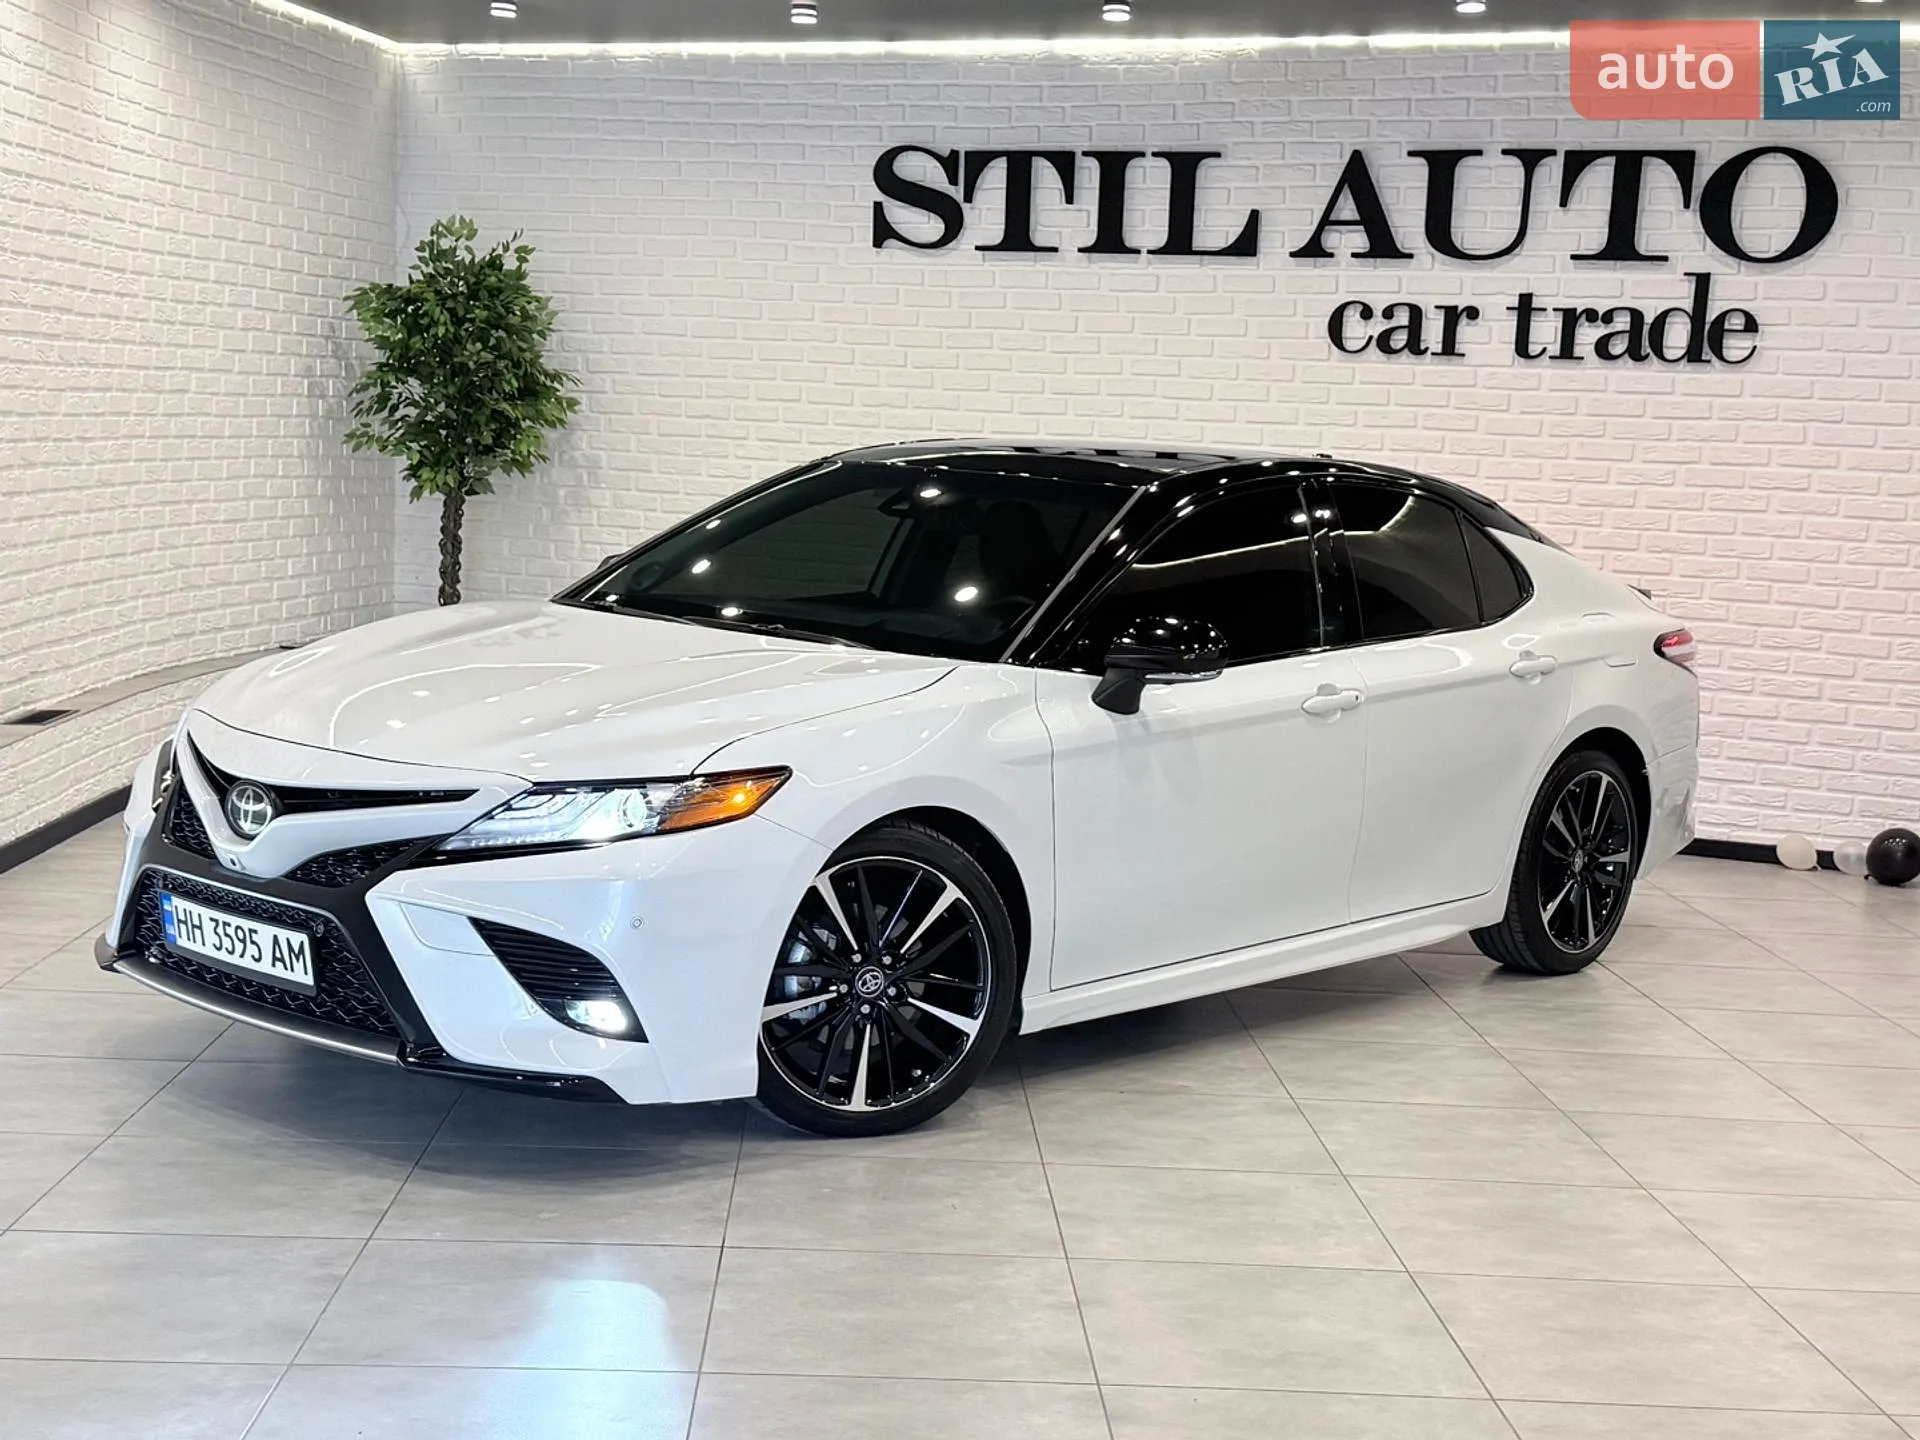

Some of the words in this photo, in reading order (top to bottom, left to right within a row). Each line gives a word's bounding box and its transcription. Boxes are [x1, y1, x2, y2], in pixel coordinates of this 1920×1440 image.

[872, 144, 1261, 258] STIL
[1288, 145, 1840, 264] AUTO
[1327, 300, 1480, 357] car
[1506, 272, 1759, 365] trade
[174, 905, 206, 948] HH
[209, 916, 263, 963] 3595
[271, 933, 309, 976] AM
